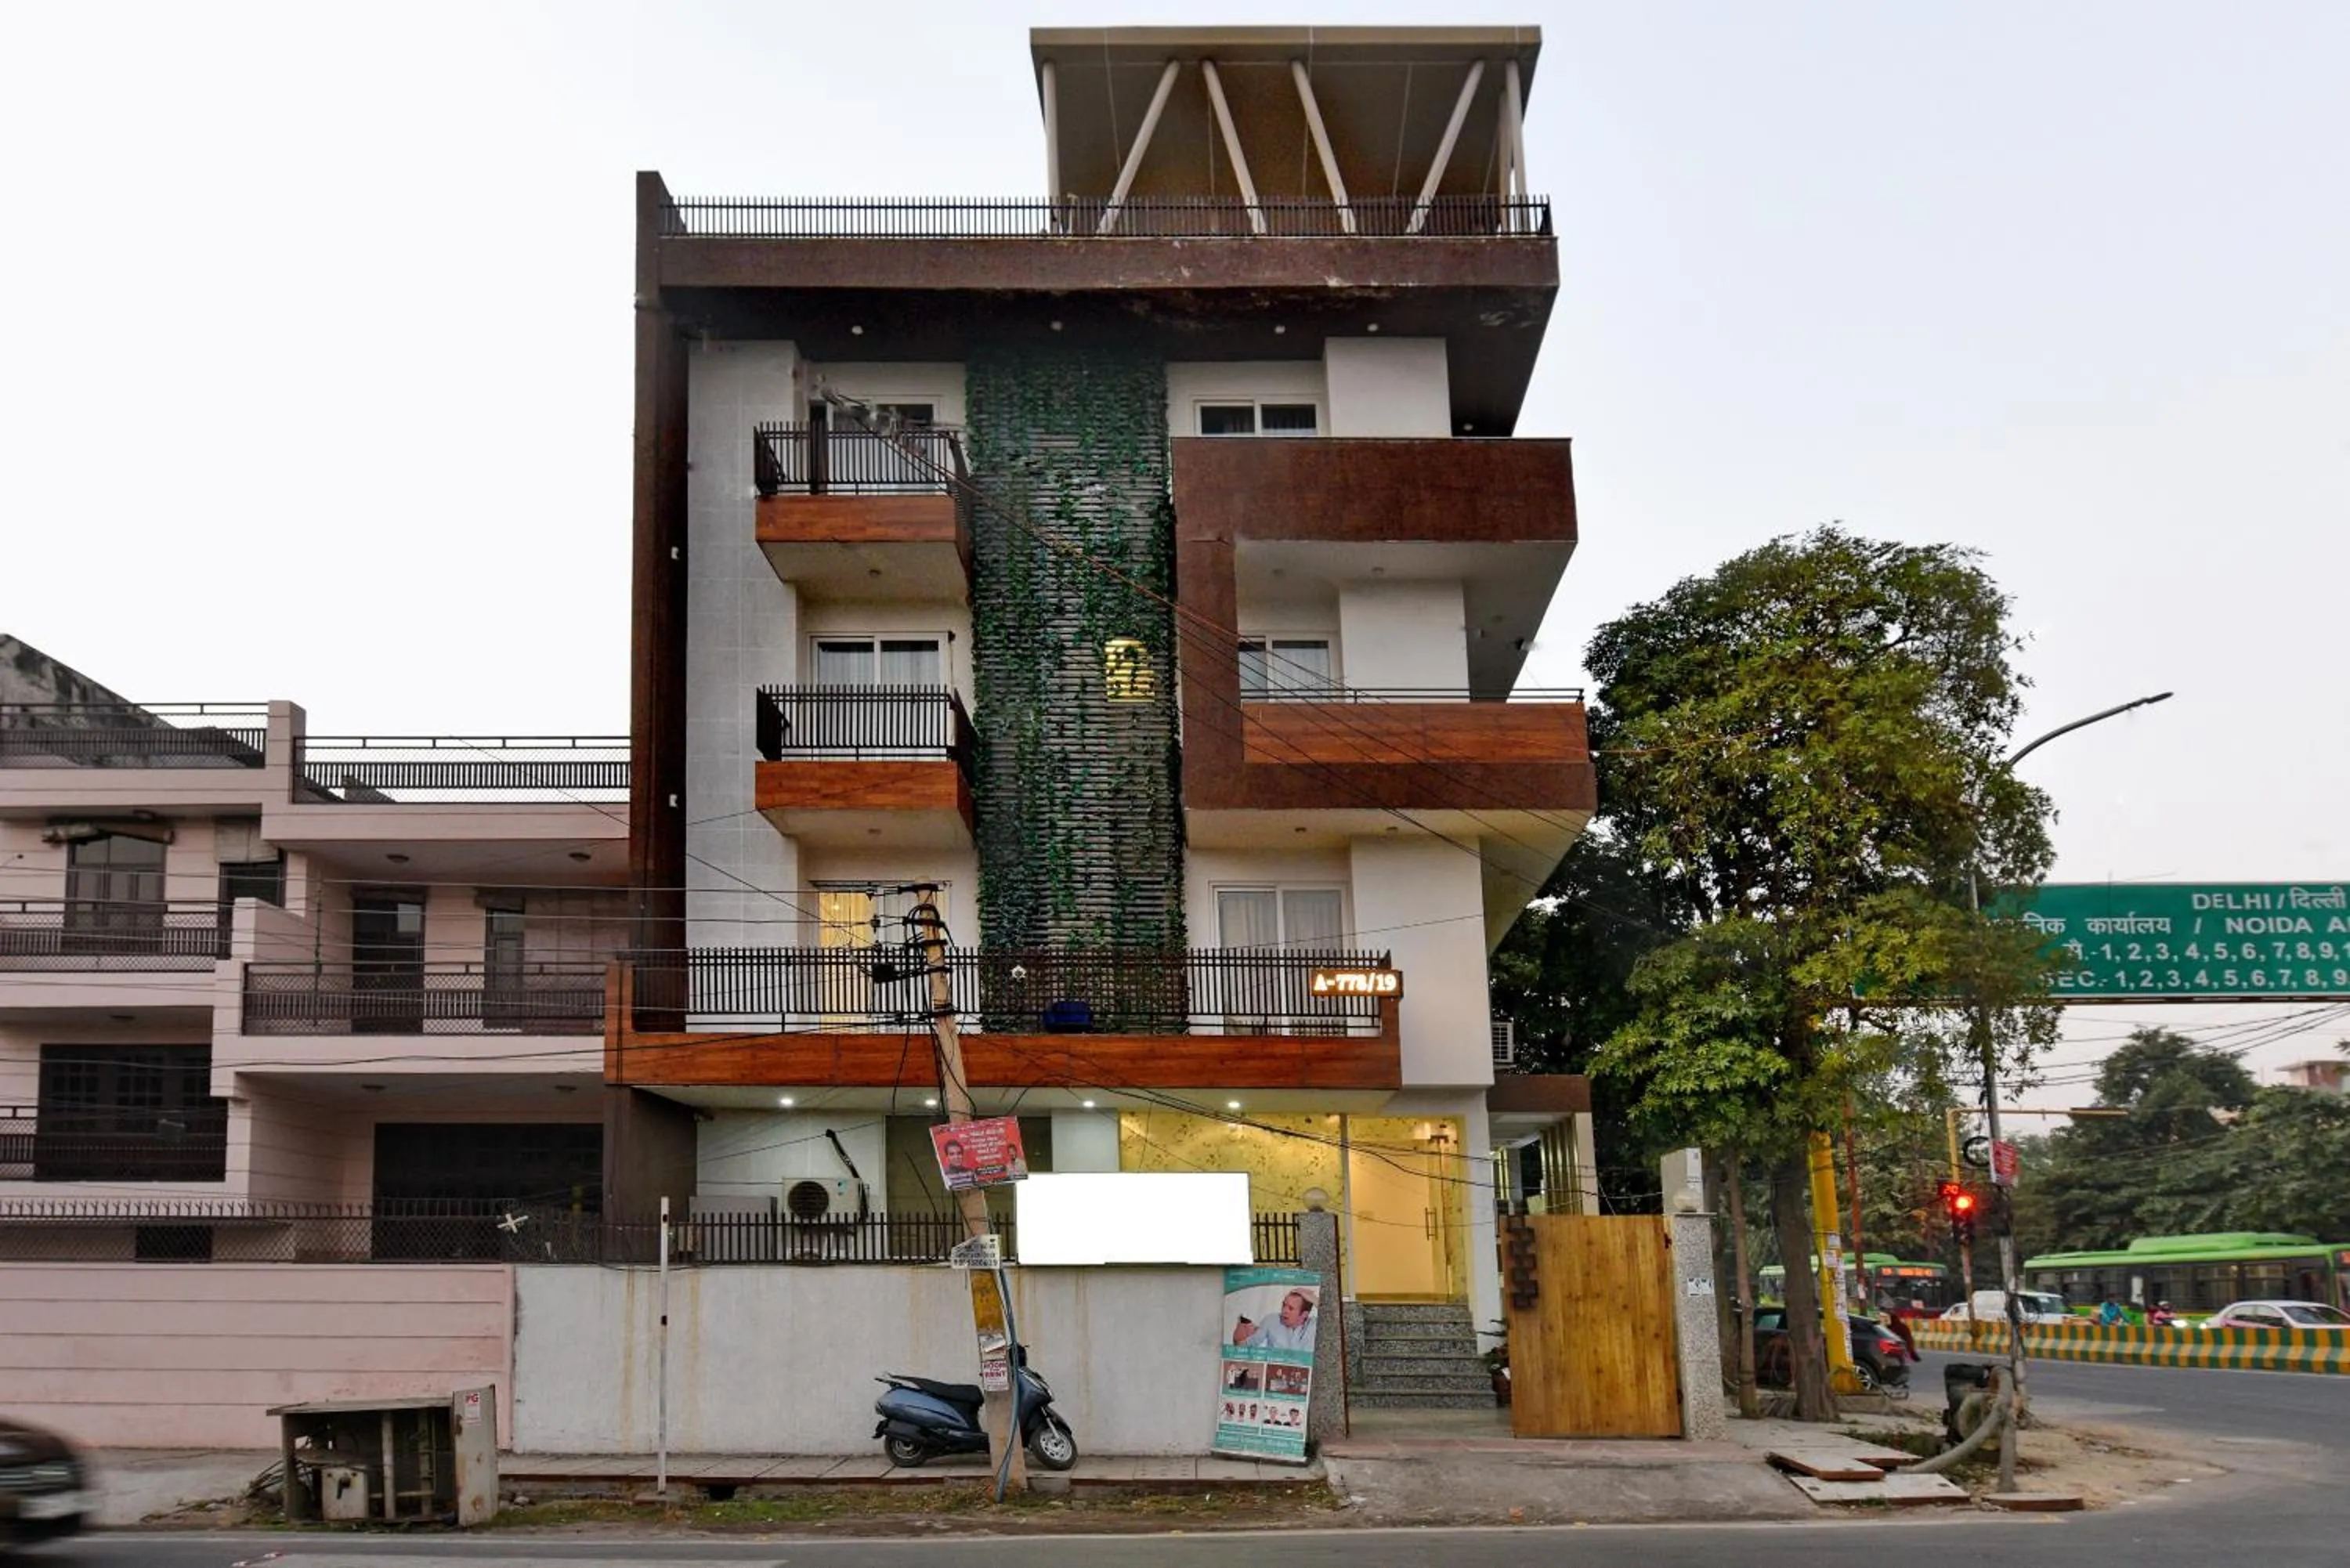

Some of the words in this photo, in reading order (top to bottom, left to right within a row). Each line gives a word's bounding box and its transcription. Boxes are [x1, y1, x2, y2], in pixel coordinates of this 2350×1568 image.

[2192, 893, 2272, 910] DELHI
[2289, 887, 2347, 909] दिल्ली
[2084, 912, 2171, 934] कार्यालय
[2225, 917, 2313, 934] NOIDA
